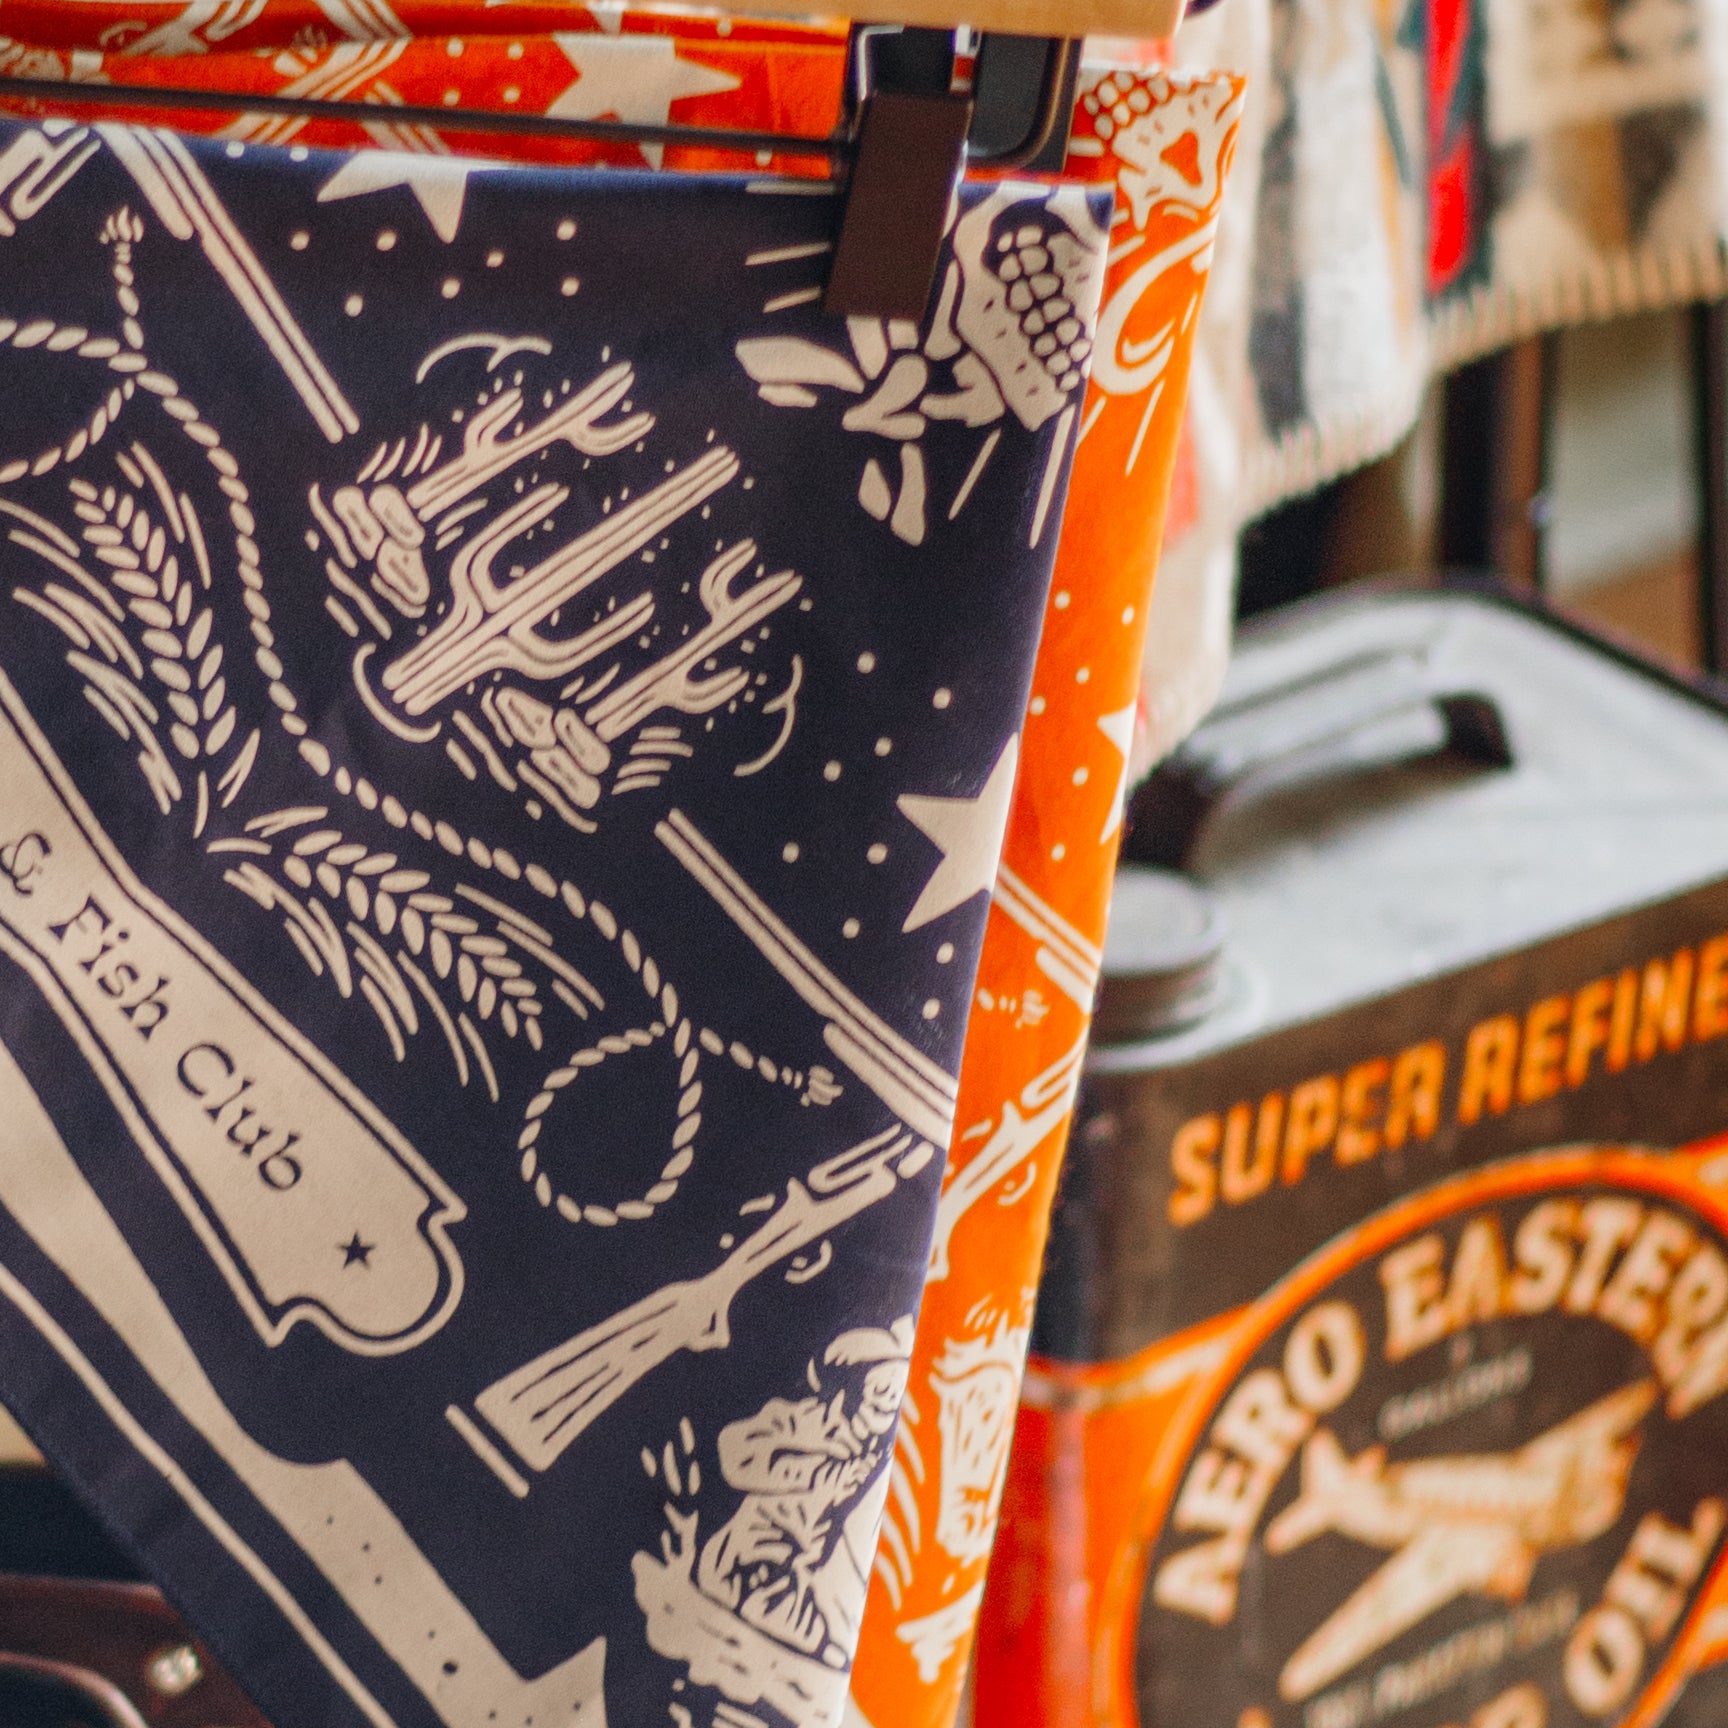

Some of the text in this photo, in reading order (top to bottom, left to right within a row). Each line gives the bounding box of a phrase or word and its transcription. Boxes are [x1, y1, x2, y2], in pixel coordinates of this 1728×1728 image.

[48, 893, 174, 1043] Fish
[174, 1041, 305, 1192] Club
[1167, 1038, 1446, 1227] SUPER
[1153, 1298, 1367, 1625] AERO
[1564, 1496, 1728, 1719] OIL
